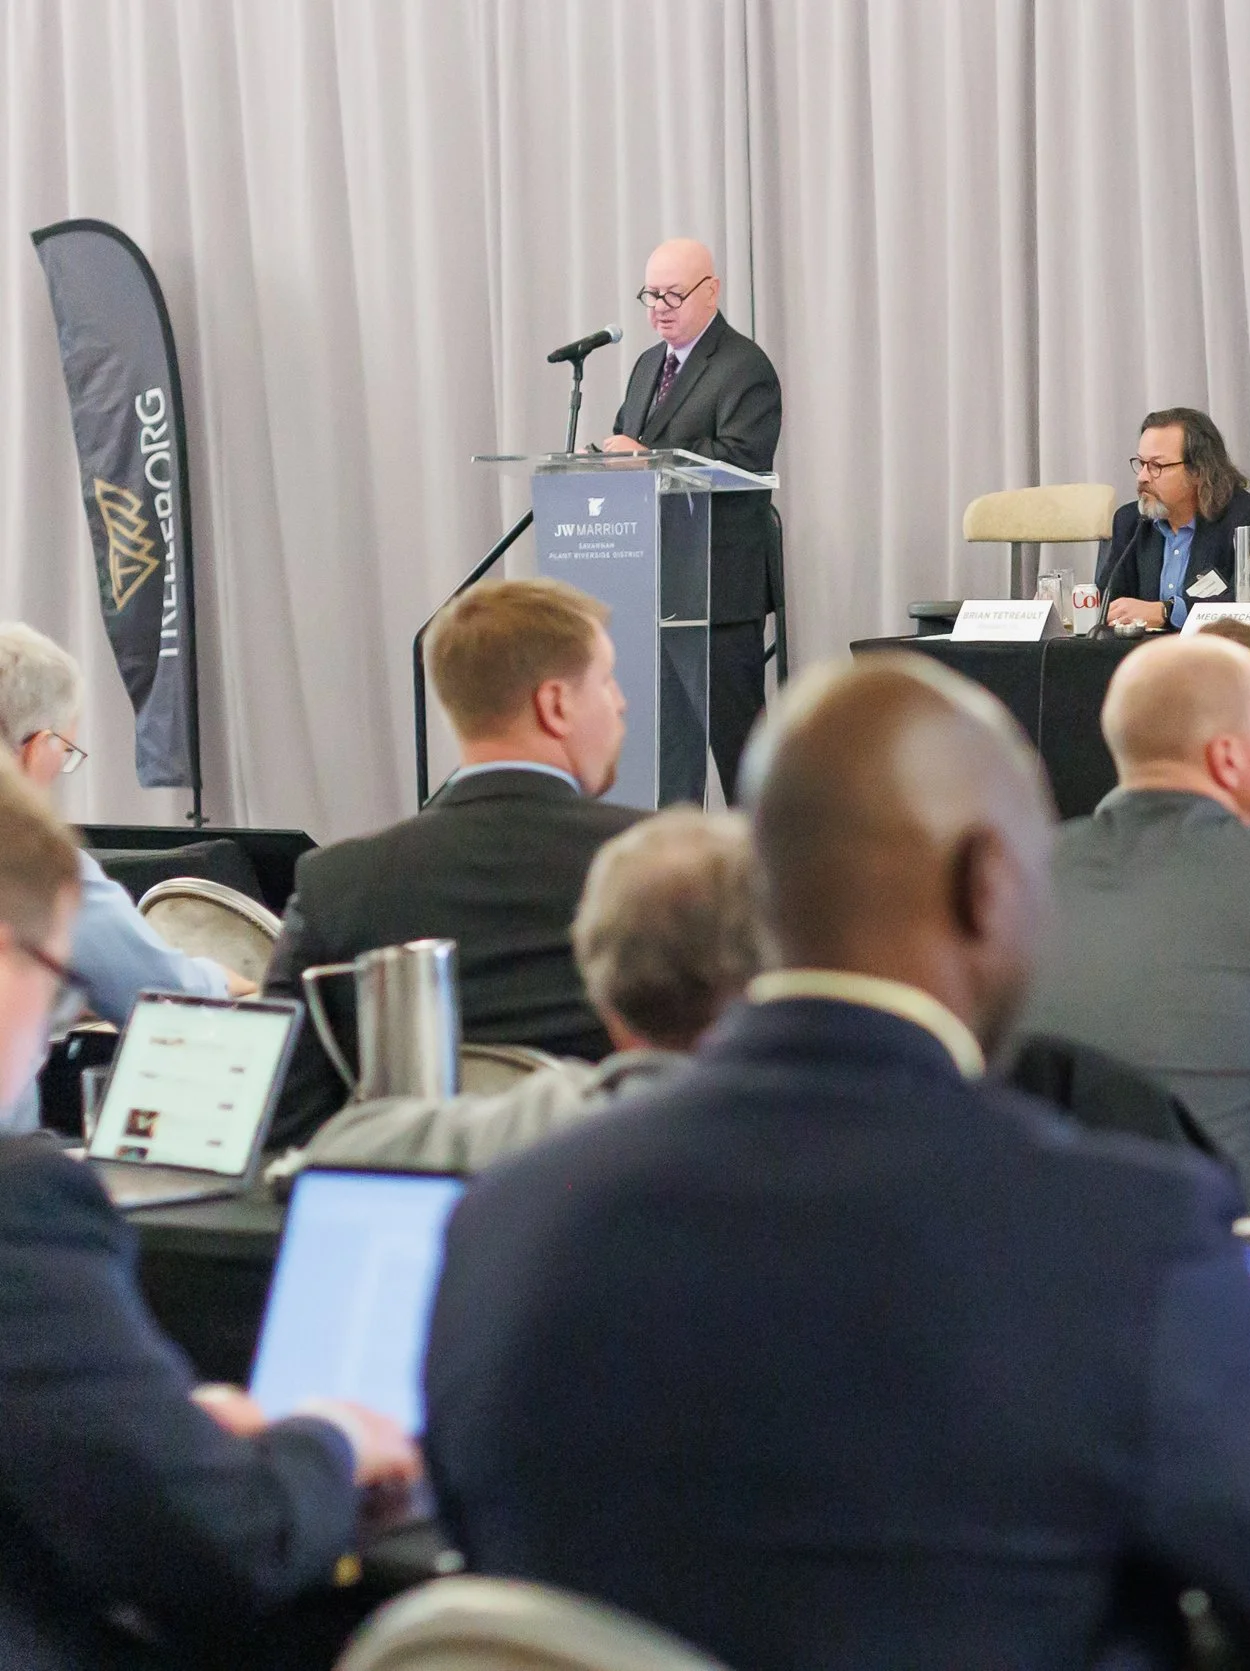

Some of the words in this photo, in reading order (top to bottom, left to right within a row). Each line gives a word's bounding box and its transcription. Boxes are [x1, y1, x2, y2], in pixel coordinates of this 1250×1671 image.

[554, 524, 575, 537] JW
[576, 522, 638, 536] MARRIOTT
[573, 551, 610, 559] RIVERSIDE
[612, 550, 644, 559] DISTRICT
[963, 611, 991, 620] BRIAN
[993, 611, 1044, 620] TETREAULT
[1195, 613, 1219, 621] MEG
